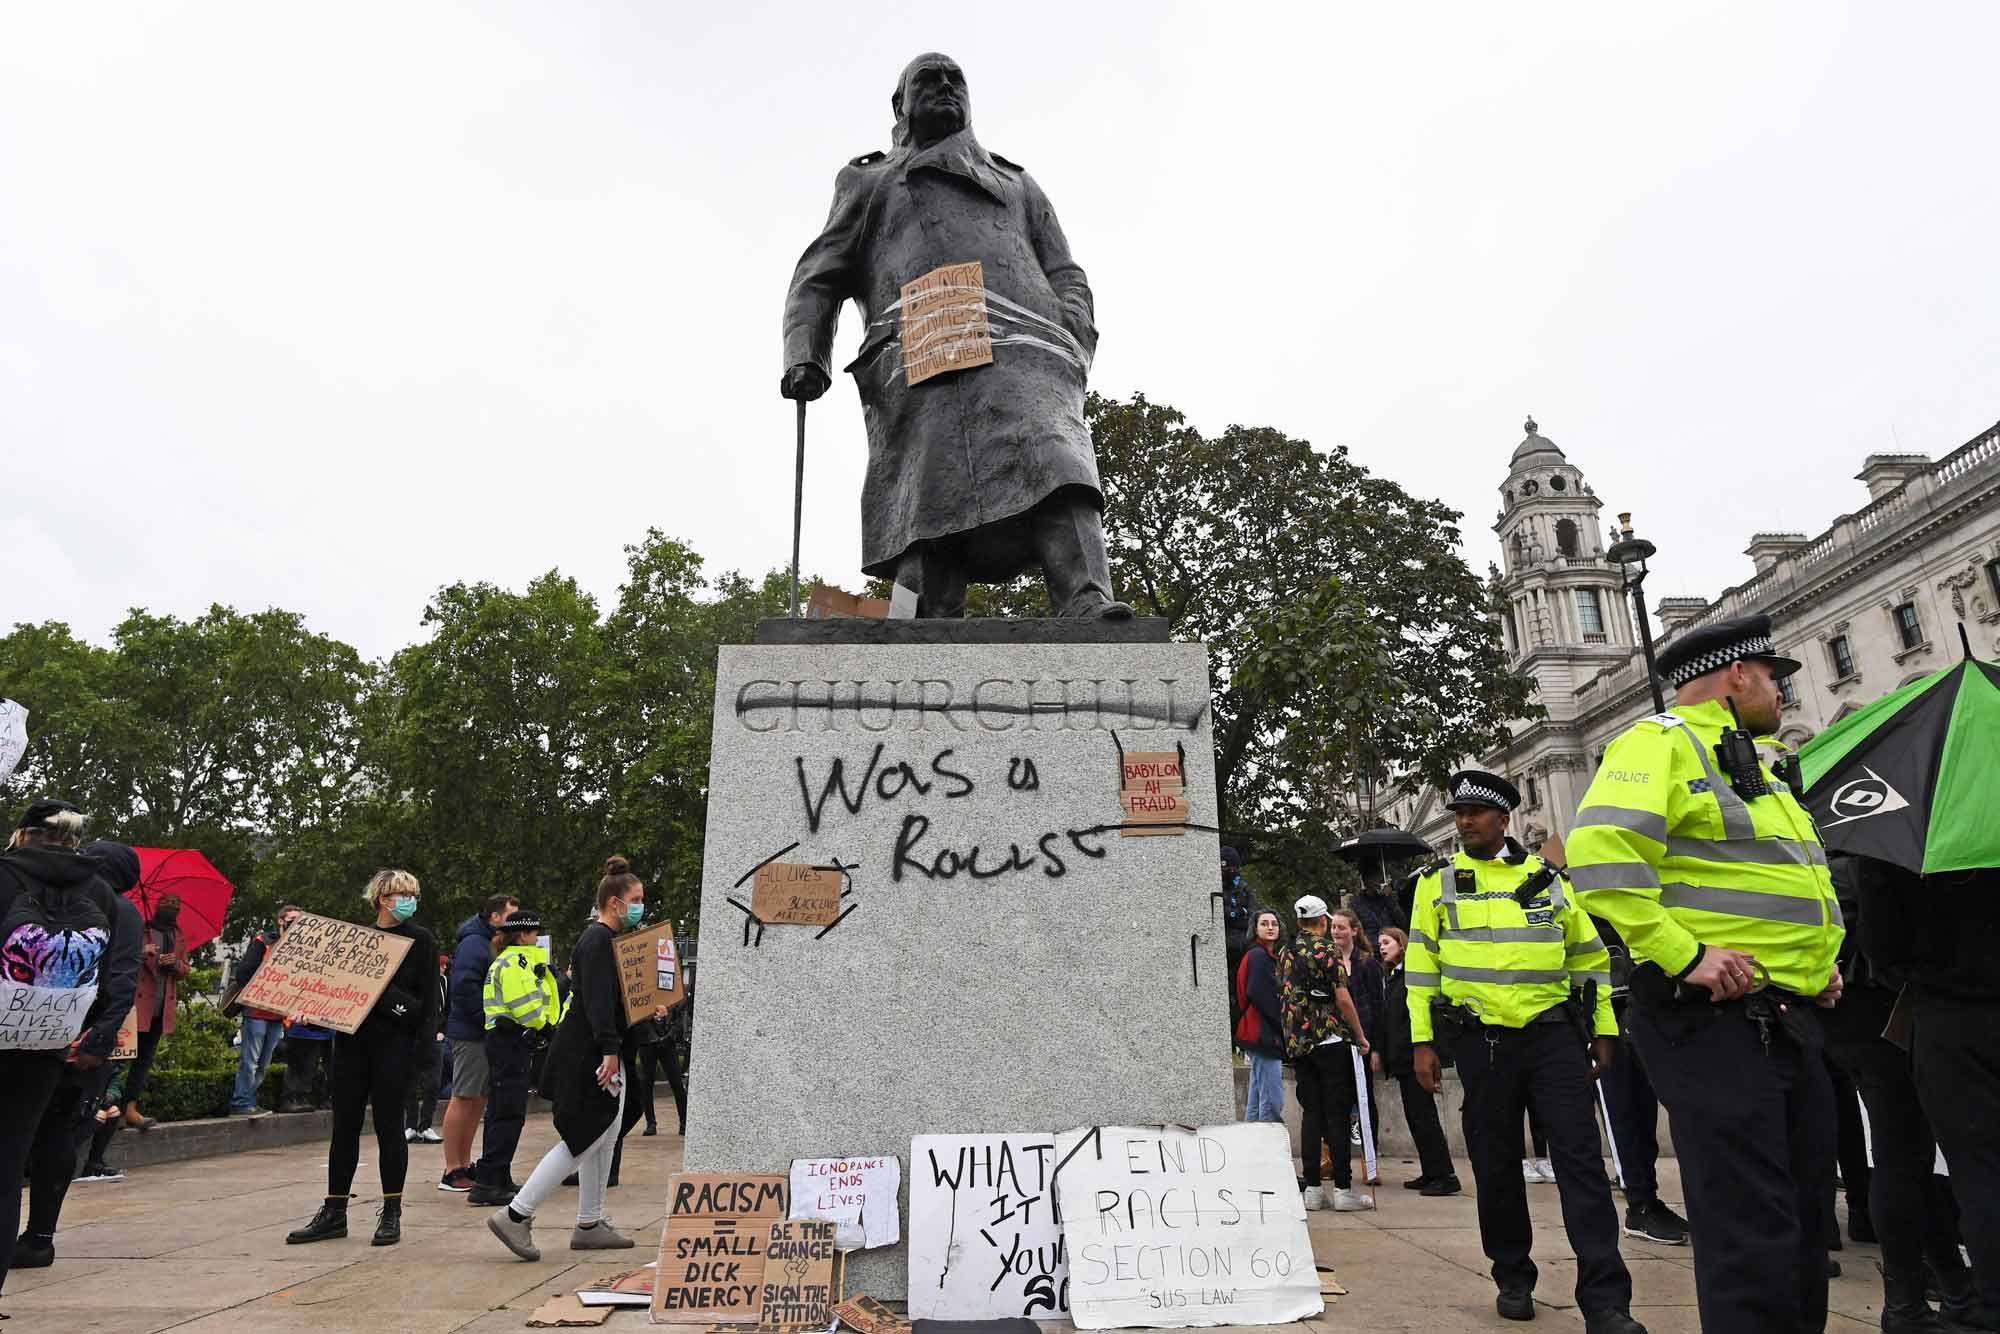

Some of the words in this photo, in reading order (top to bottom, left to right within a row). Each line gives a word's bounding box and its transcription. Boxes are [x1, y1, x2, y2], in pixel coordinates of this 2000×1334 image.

[906, 264, 984, 316] BLACK
[737, 678, 1200, 732] CHURCHILL
[1125, 764, 1181, 779] BABYLON
[1607, 771, 1650, 784] POLICE
[1145, 780, 1160, 795] AH
[1130, 796, 1176, 814] FRAUD
[288, 929, 322, 948] think
[325, 939, 345, 959] the
[346, 944, 390, 968] British
[270, 953, 294, 967] for
[314, 951, 335, 966] was
[338, 960, 349, 970] a
[348, 960, 386, 979] force
[257, 966, 289, 987] Stop
[7, 988, 86, 1013] BLACK
[245, 983, 271, 1000] the
[0, 1012, 65, 1028] LIVES
[1126, 1137, 1226, 1174] END
[807, 1160, 884, 1177] IGNORANCE
[928, 1140, 1054, 1197] WHAT
[830, 1174, 863, 1191] ENDS
[672, 1183, 785, 1214] RACISM
[1095, 1188, 1276, 1235] RACIST
[771, 1223, 793, 1240] BE
[800, 1223, 835, 1240] THE
[676, 1236, 761, 1259] SMALL
[767, 1241, 833, 1261] CHANGE
[684, 1262, 741, 1283] DICK
[1081, 1243, 1232, 1285] SECTION
[1250, 1248, 1291, 1279] 60
[664, 1284, 758, 1309] ENERGY
[763, 1284, 800, 1304] SIGN
[803, 1285, 828, 1303] THE
[761, 1303, 828, 1323] PETITION
